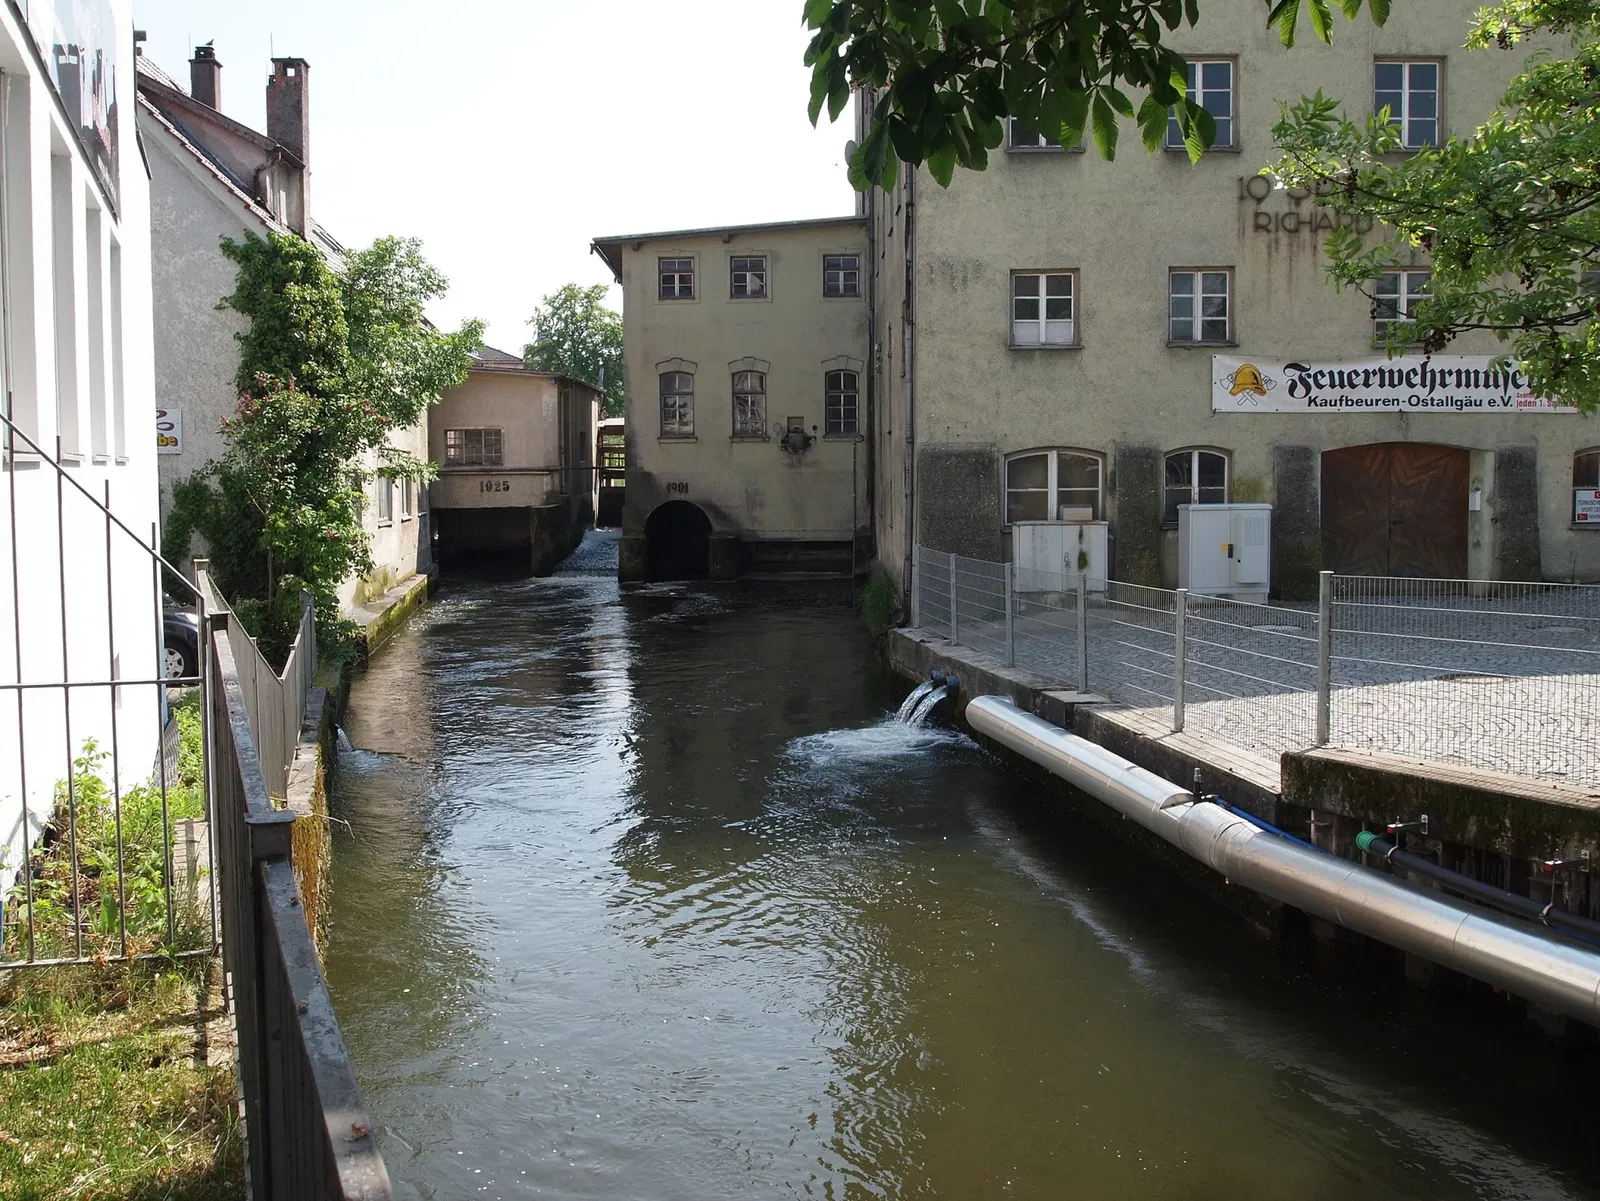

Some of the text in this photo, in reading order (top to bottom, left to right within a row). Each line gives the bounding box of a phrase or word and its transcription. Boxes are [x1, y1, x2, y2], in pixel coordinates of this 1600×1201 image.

[1308, 394, 1513, 411] Kaufbeuren-Ostallgäu e.V.
[1516, 399, 1537, 408] jeden
[480, 480, 510, 492] 1925
[667, 481, 689, 494] 1901
